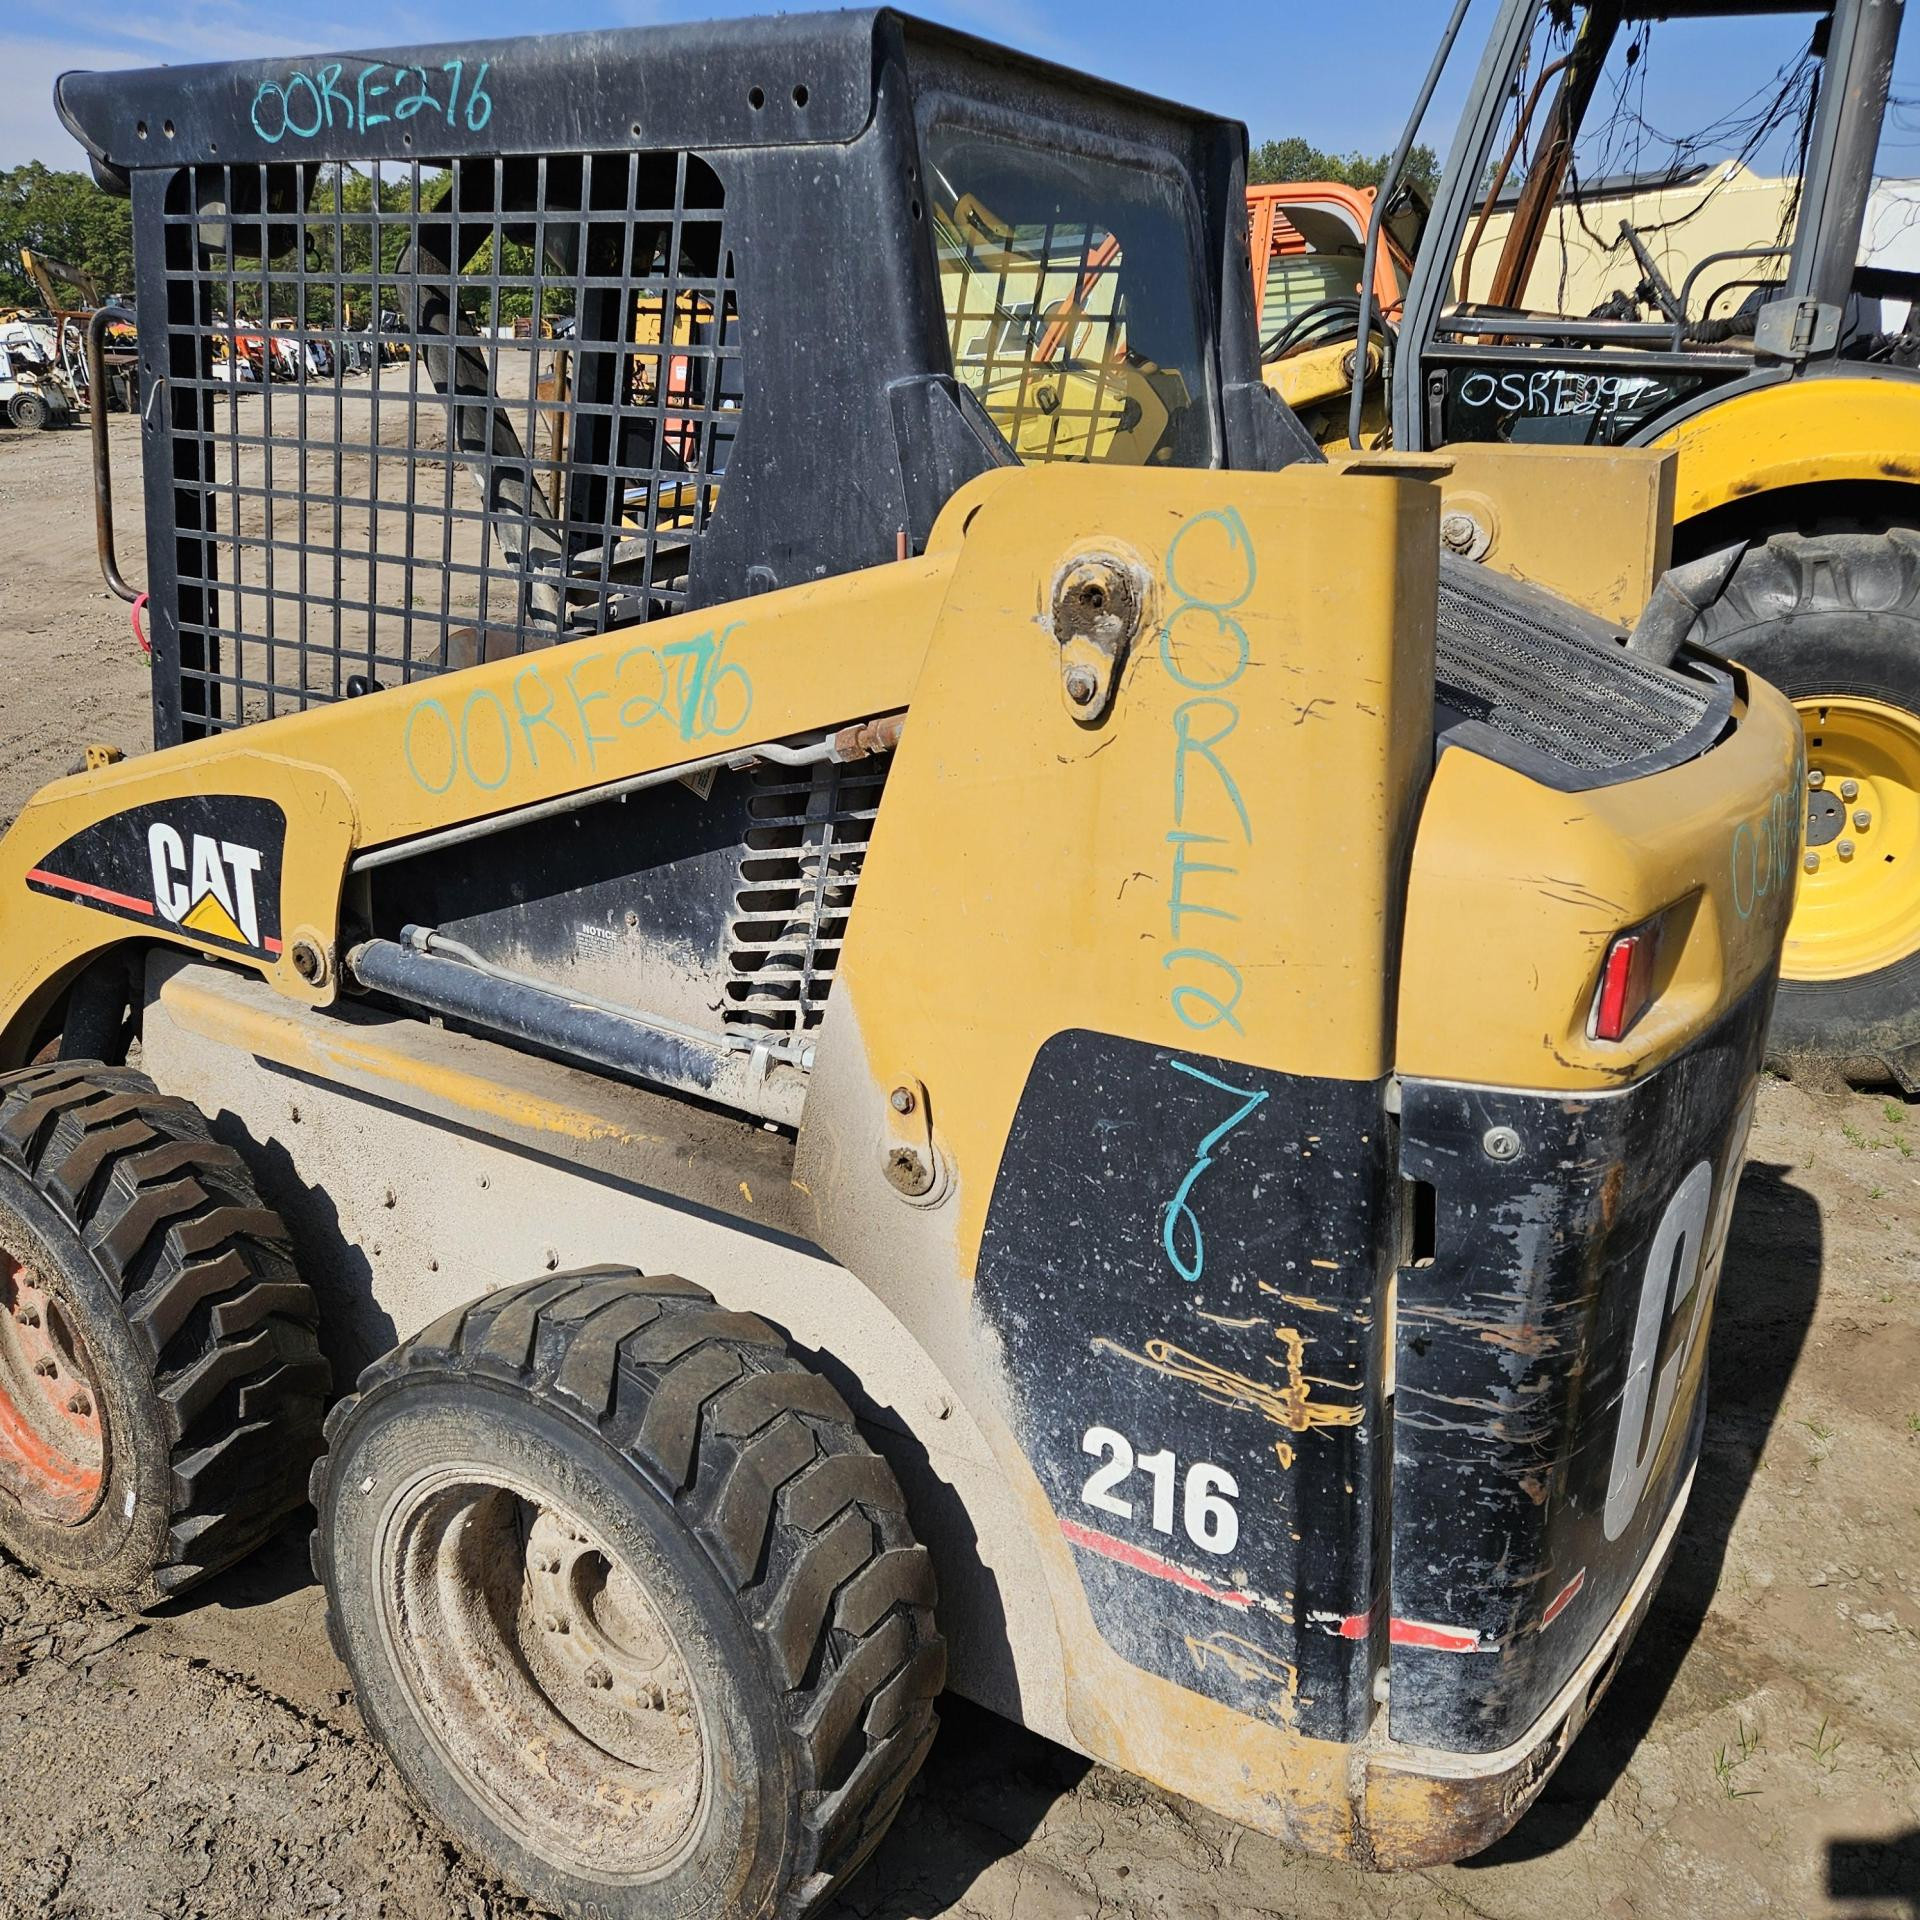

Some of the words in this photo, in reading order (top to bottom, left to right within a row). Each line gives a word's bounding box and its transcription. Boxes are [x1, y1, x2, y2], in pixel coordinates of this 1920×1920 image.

[148, 822, 262, 948] CAT
[582, 923, 618, 941] NOTICE
[1081, 1426, 1240, 1555] 216
